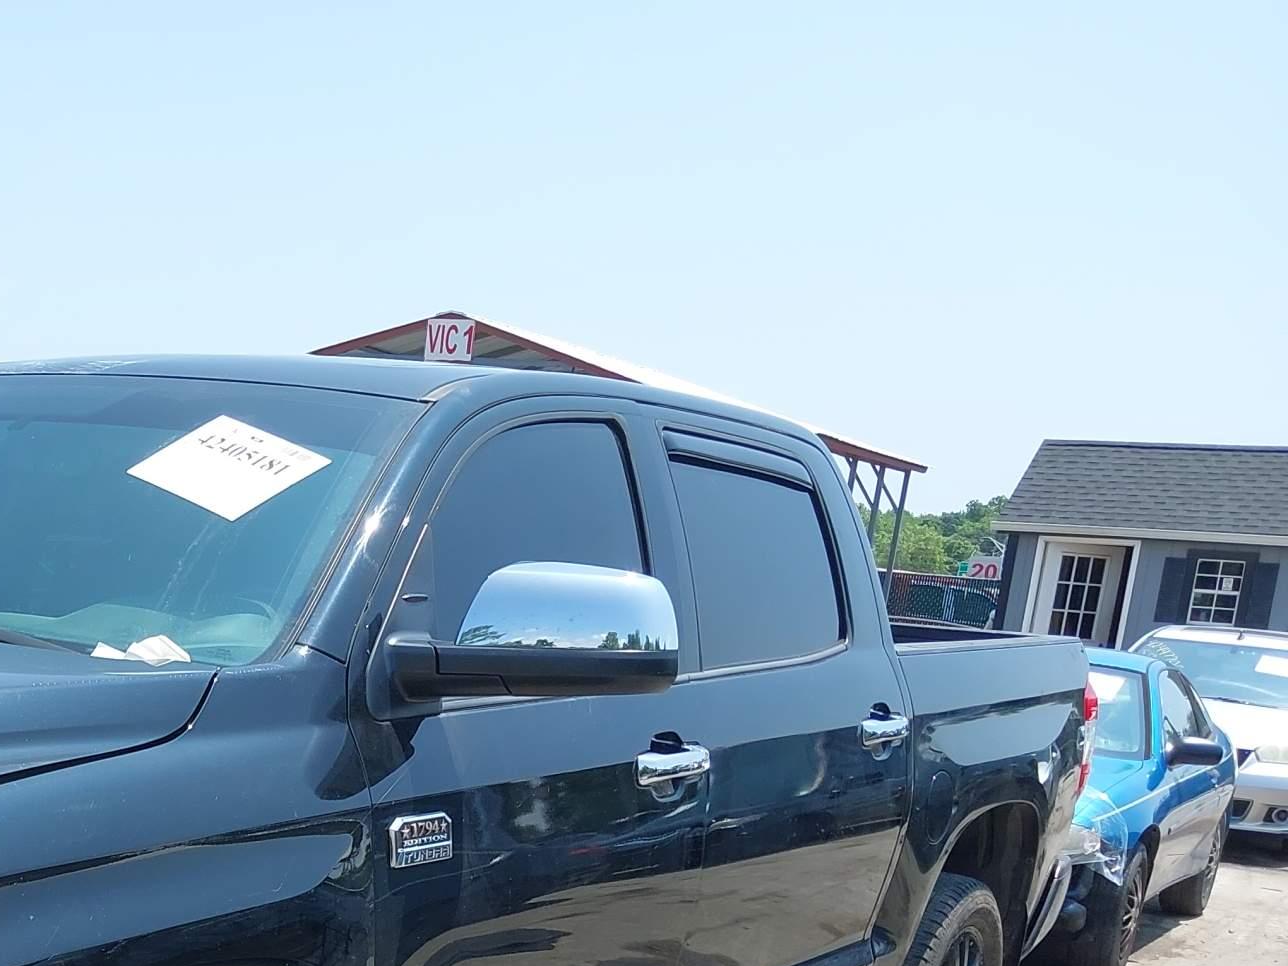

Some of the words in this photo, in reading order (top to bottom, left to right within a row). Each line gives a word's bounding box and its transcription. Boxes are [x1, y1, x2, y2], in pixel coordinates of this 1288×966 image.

[428, 324, 458, 354] VIC
[463, 325, 474, 354] 1
[198, 434, 291, 476] 42405181
[969, 564, 998, 579] 20
[410, 820, 440, 838] 1794
[402, 833, 448, 846] EDITION
[406, 846, 450, 864] TUNDRA
